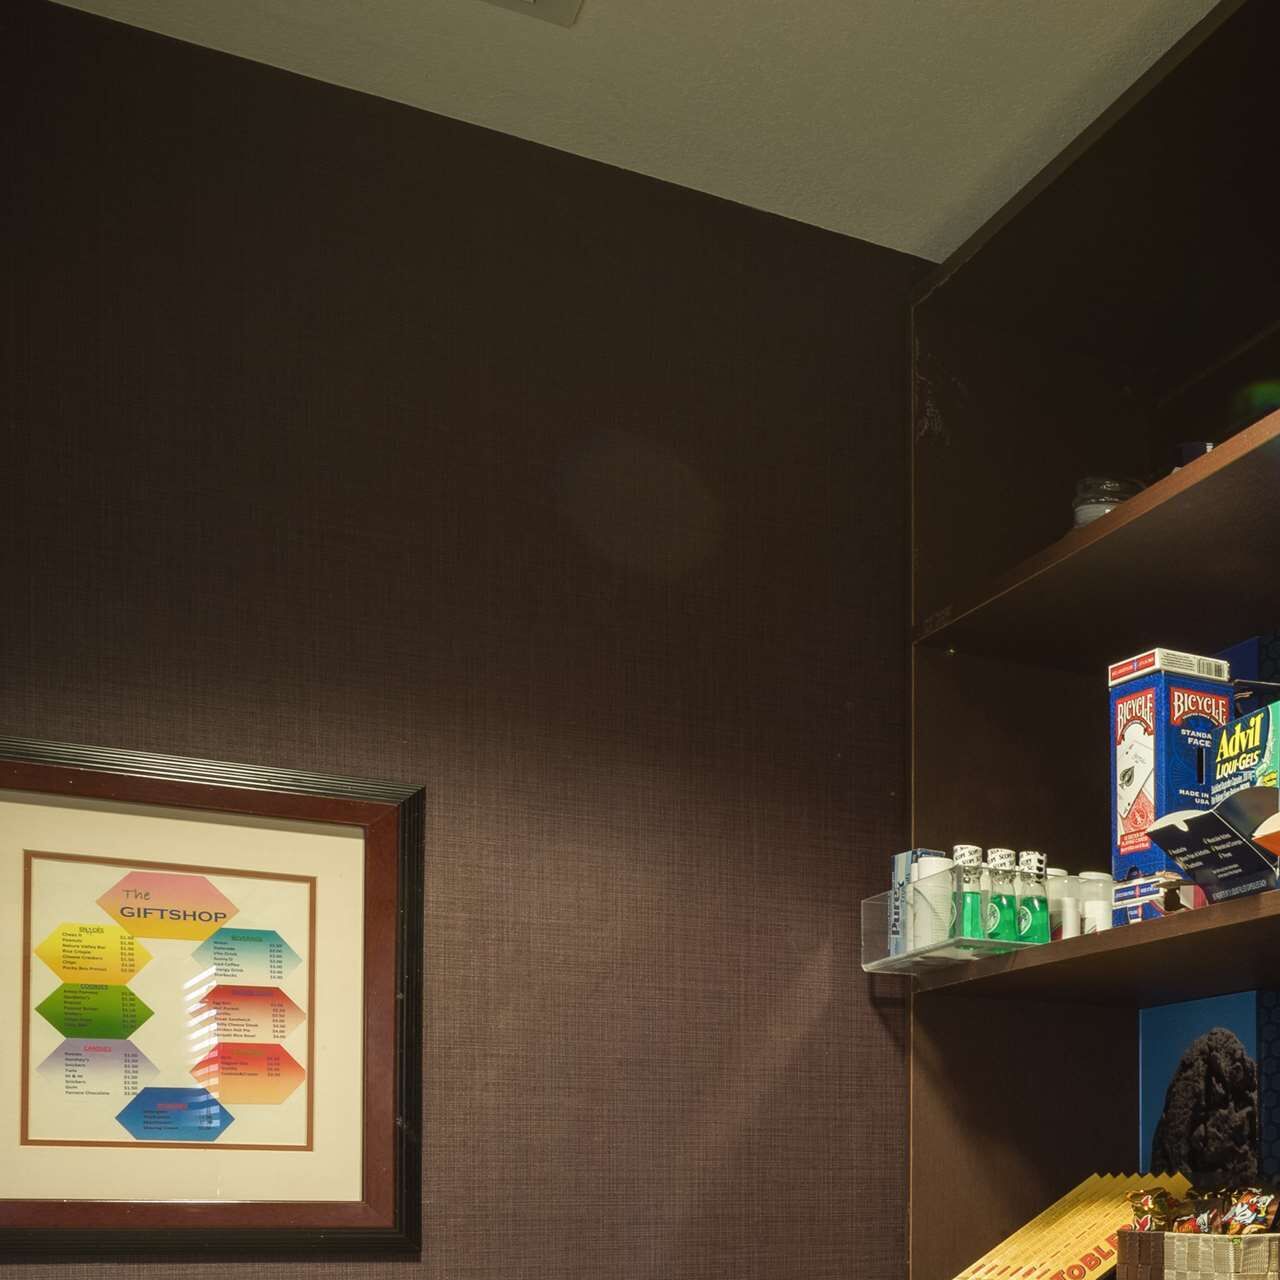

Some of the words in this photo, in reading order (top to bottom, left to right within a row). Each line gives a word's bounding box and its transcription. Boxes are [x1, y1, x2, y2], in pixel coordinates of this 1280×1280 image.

[1118, 694, 1153, 734] BICYCLE
[1173, 691, 1226, 725] BICYCLE
[1181, 729, 1212, 739] STANDA
[1216, 713, 1262, 763] Advil
[1188, 738, 1212, 747] FACE
[1179, 789, 1200, 798] MADE
[122, 888, 151, 900] The
[120, 906, 227, 923] GIFTSHOP
